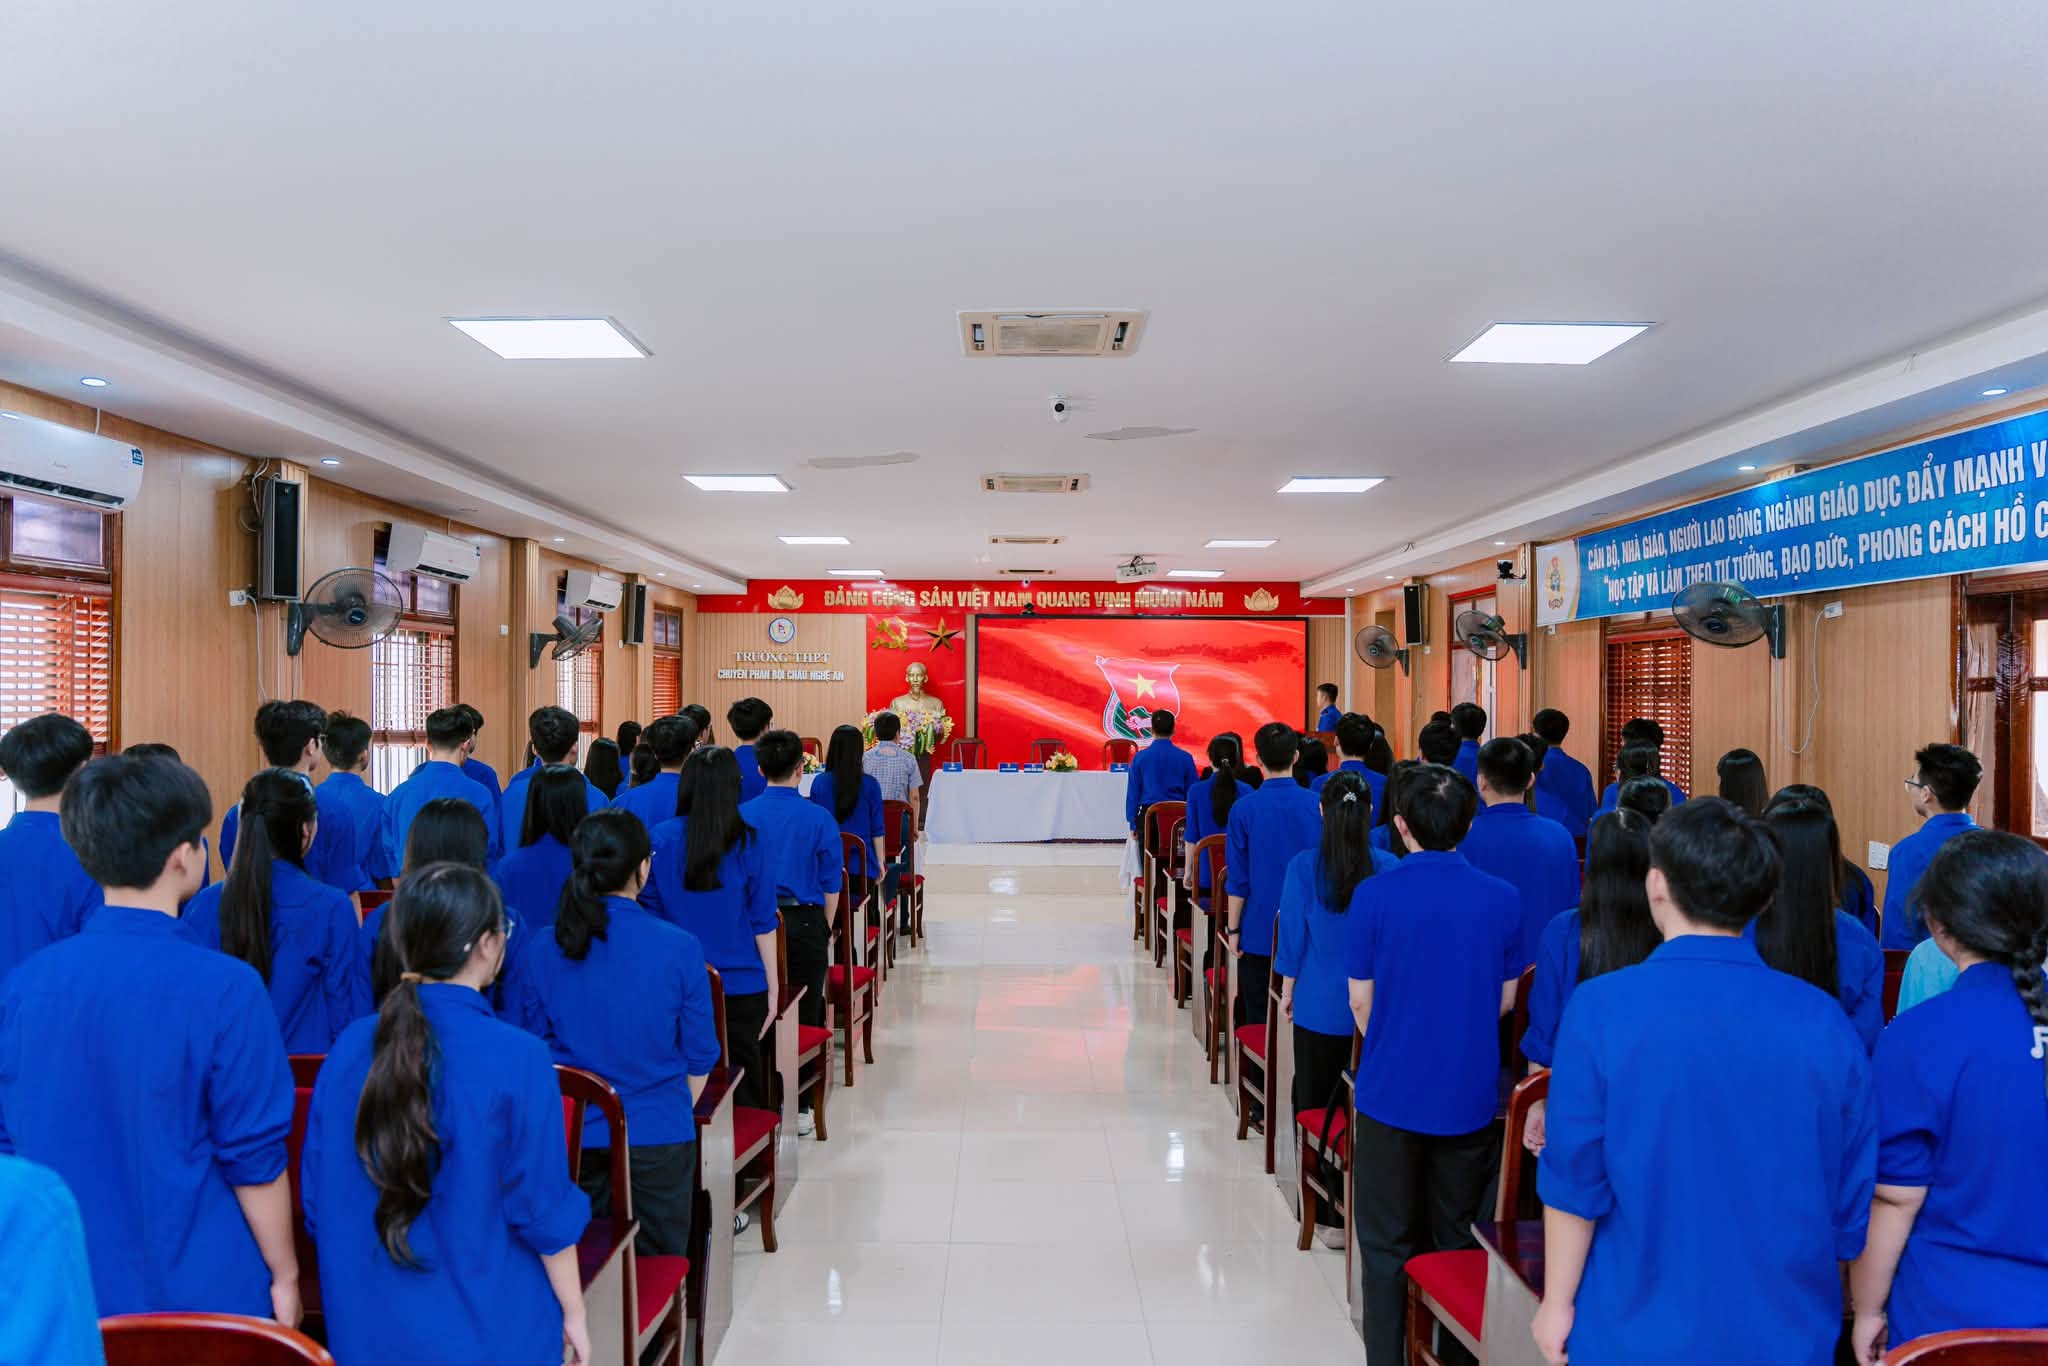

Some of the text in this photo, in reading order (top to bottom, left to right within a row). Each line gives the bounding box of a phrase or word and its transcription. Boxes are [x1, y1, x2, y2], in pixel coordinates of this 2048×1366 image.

[1588, 544, 1604, 572] CÁN
[1606, 539, 1620, 571] BỘ,
[1622, 533, 1641, 564] NHÀ
[1642, 529, 1667, 559] GIÁO,
[1669, 518, 1702, 554] NGƯỜI
[1704, 517, 1725, 546] LAO
[1728, 506, 1762, 544] ĐỘNG
[1765, 494, 1815, 533] NGÀNH
[1820, 481, 1859, 521] GIÁO
[1863, 474, 1901, 517] DỤC
[1906, 452, 1946, 504] ĐẨY
[1953, 445, 2024, 498] MẠNH
[1627, 570, 1645, 604] TẬP
[1646, 567, 1659, 596] VÀ
[1661, 564, 1683, 595] LÀM
[1715, 555, 1731, 584] TƯ
[1732, 544, 1778, 583] TƯỞNG,
[1781, 543, 1811, 581] ĐẠO
[1815, 532, 1854, 571] ĐỨC,
[1858, 523, 1922, 564] PHONG
[1929, 510, 1987, 554] CÁCH
[1994, 492, 2026, 545] HỒ
[824, 585, 1224, 610] ĐẢNG CỘNG SẢN VIỆT NAM QUANG VINH MUÔN NĂM
[794, 652, 831, 663] THPT
[833, 671, 844, 681] AN
